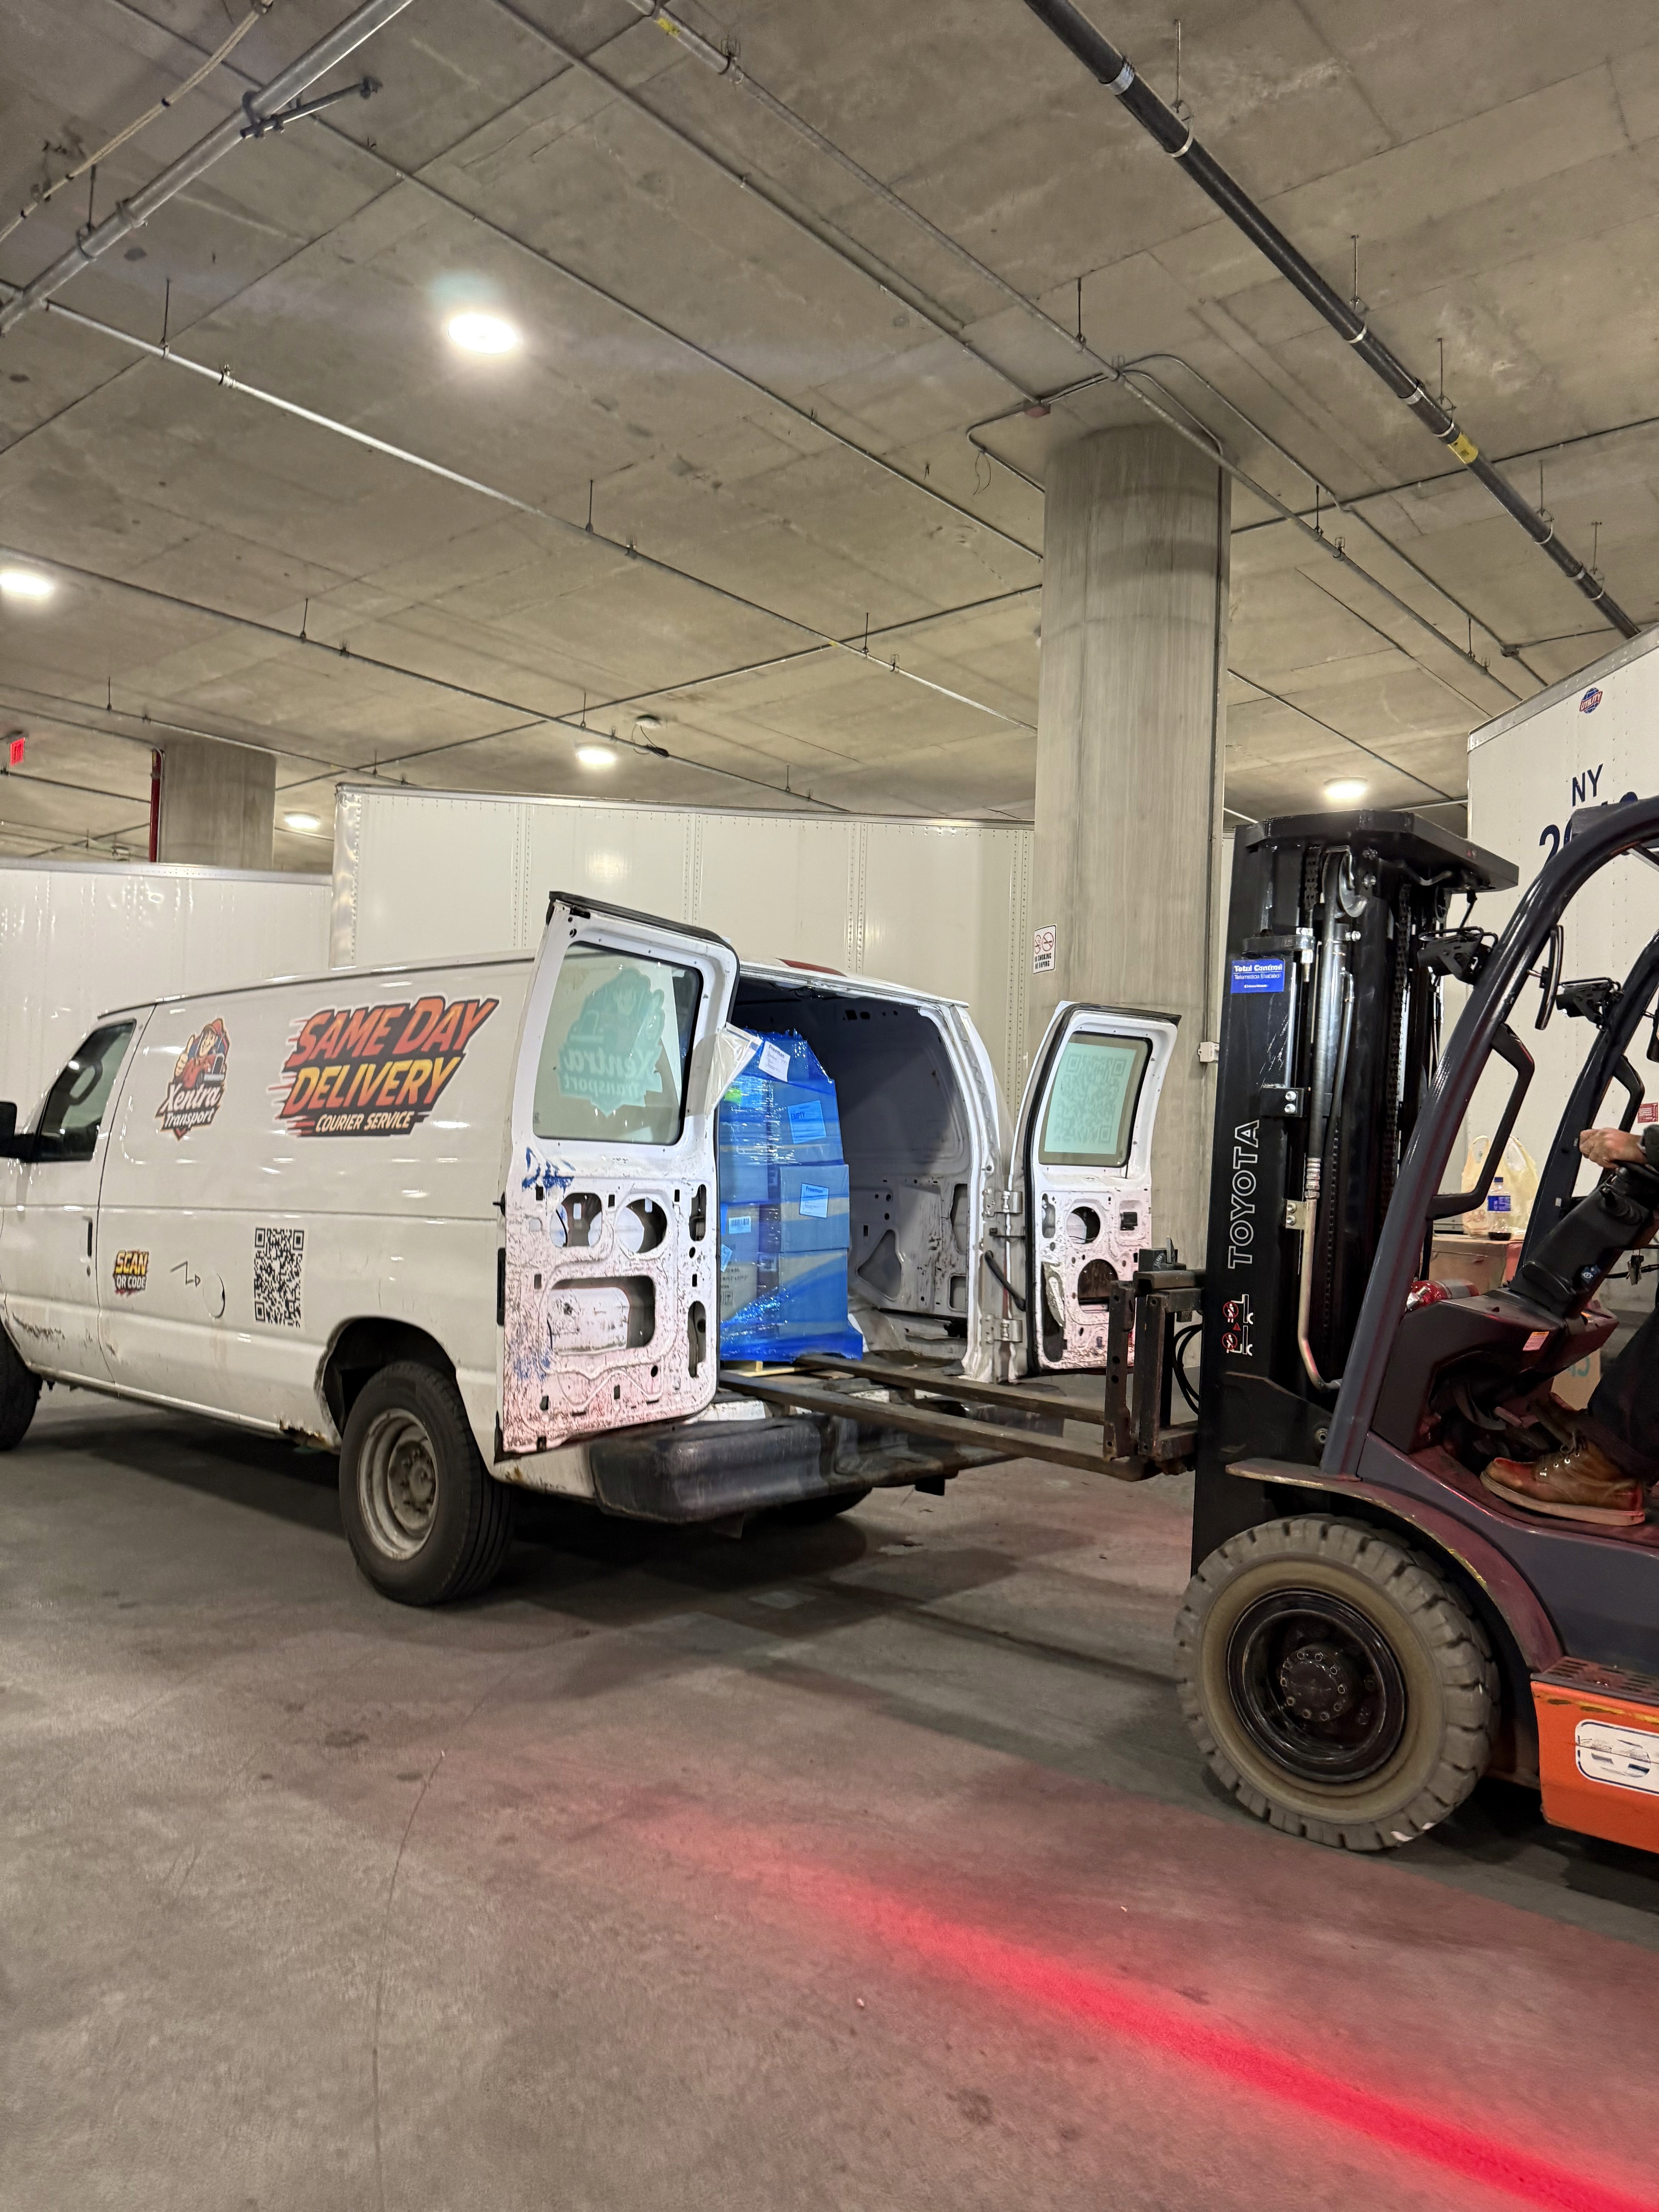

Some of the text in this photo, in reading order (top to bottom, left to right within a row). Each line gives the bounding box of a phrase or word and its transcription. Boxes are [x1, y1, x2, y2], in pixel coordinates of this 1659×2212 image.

[1580, 691, 1602, 710] UTILITY
[1572, 763, 1603, 807] NY
[1038, 953, 1051, 961] SMOKING
[285, 998, 497, 1068] SAME DAY
[282, 1056, 461, 1115] DELIVERY
[159, 1083, 221, 1114] Xentra
[164, 1108, 215, 1128] Transport
[315, 1111, 415, 1133] COURIER SERVICE
[791, 1111, 805, 1120] EMPTY
[1228, 1119, 1259, 1269] TOYOTA
[115, 1252, 148, 1276] SCAN
[116, 1274, 146, 1290] QR CODE
